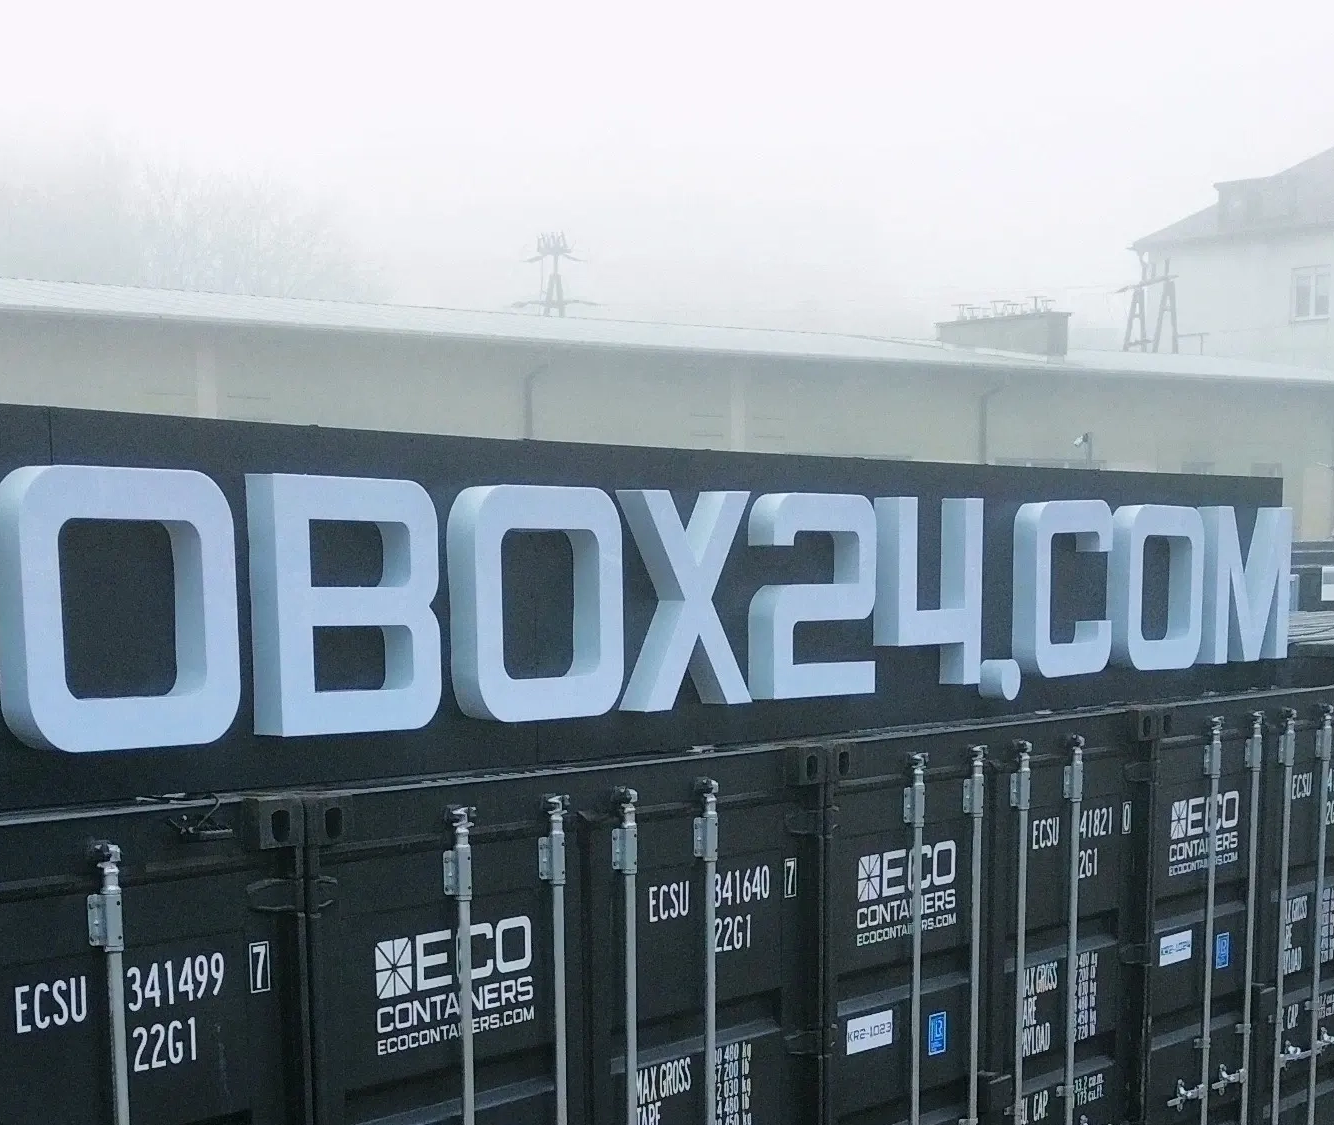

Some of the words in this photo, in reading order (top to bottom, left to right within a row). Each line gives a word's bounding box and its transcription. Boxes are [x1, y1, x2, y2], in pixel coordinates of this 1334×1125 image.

[1292, 772, 1312, 800] ECSU
[1033, 817, 1060, 849] ECSU
[1080, 807, 1113, 838] 41821
[1123, 802, 1131, 833] 0
[1187, 790, 1239, 836] ECO
[1080, 848, 1097, 878] 2G1
[1169, 831, 1238, 862] CONTAIERS
[882, 840, 956, 897] ECO
[649, 880, 689, 923] ECSU
[715, 865, 770, 908] 341640
[785, 859, 796, 896] 7
[857, 889, 955, 929] CONTAIERS
[715, 914, 751, 952] 22G1
[416, 916, 532, 991] ECO
[15, 975, 87, 1034] ECSU
[127, 953, 224, 1012] 341499
[251, 943, 268, 991] 7
[1036, 962, 1057, 993] GROSS
[377, 976, 533, 1034] CONTANERS
[1023, 996, 1037, 1028] ARE
[133, 1017, 197, 1072] 22G1
[377, 1005, 534, 1055] ECOCONTAIERS.COM
[848, 1022, 892, 1042] KR2-1023
[1023, 1022, 1050, 1057] AYLOAD
[724, 1043, 739, 1061] 480
[742, 1041, 751, 1061] kg
[724, 1061, 738, 1080] 200
[742, 1058, 749, 1074] lb
[637, 1066, 657, 1104] MAX
[660, 1057, 691, 1098] GROSS
[717, 1083, 722, 1100] 2
[724, 1078, 738, 1098] 030
[742, 1076, 751, 1096] kg
[717, 1100, 722, 1117] 4
[724, 1096, 739, 1115] 480
[742, 1093, 749, 1110] lb
